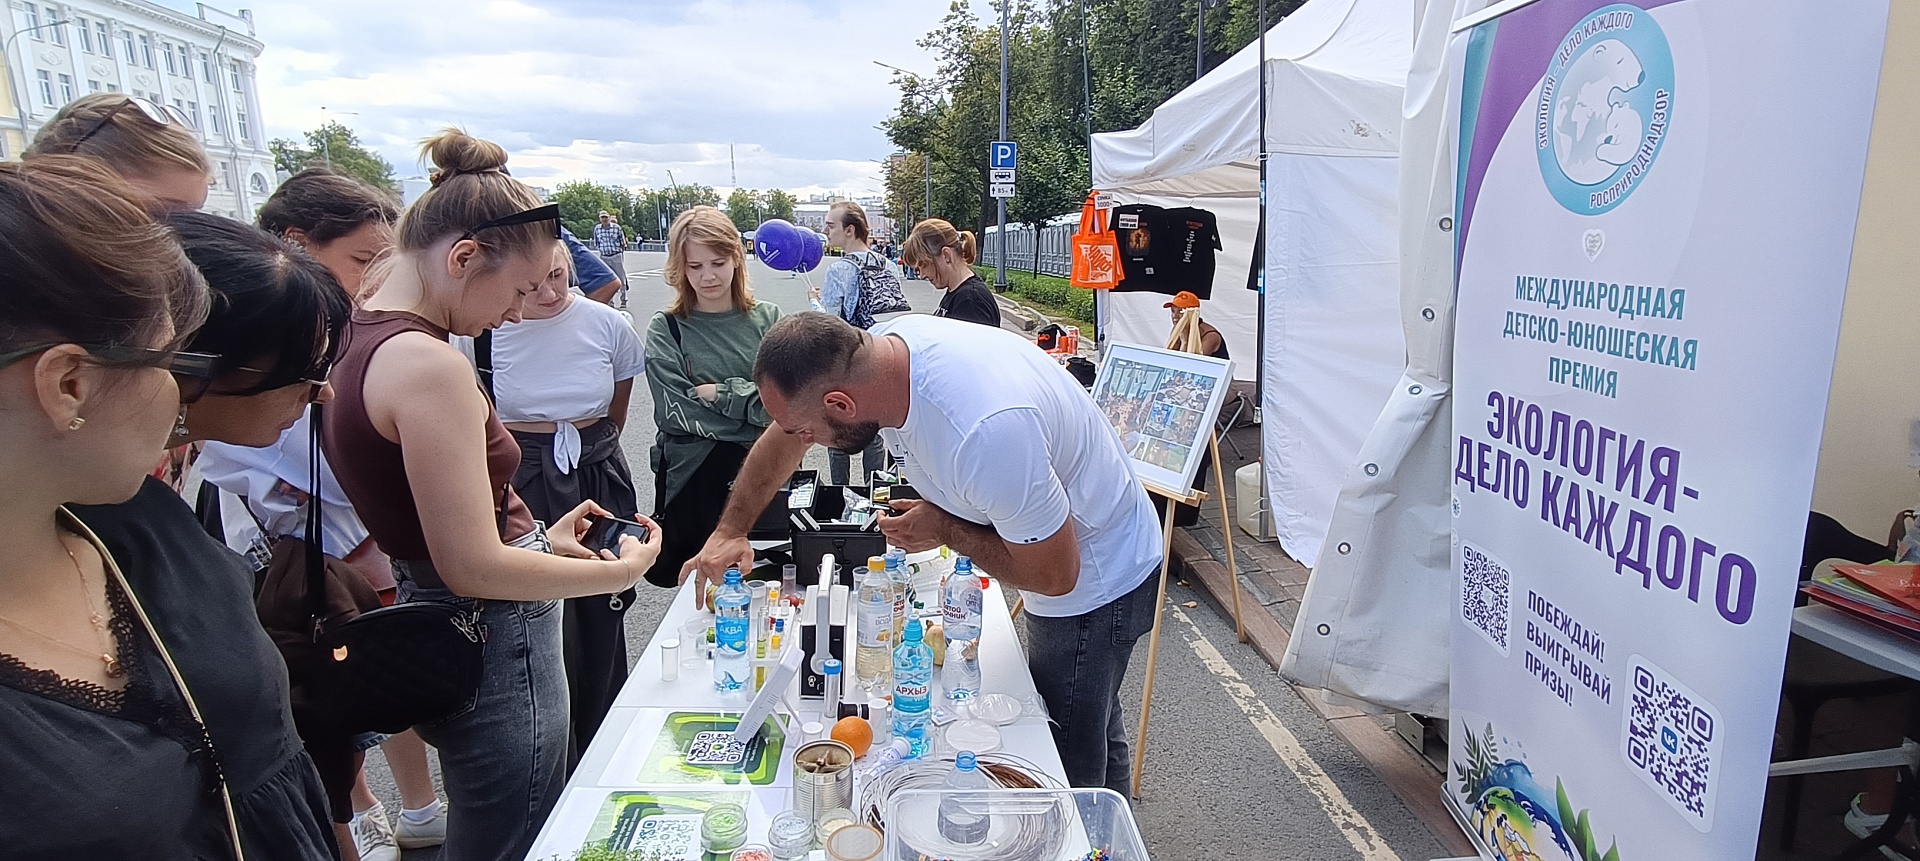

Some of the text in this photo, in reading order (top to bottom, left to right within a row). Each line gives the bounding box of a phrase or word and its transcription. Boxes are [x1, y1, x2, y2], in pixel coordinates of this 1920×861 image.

[1539, 77, 1556, 148] ЭКОЛОГИЯ
[1558, 31, 1582, 67] ДЕЛО
[1583, 12, 1634, 38] КАЖДОГО
[998, 145, 1011, 165] P
[1589, 89, 1669, 208] РОСПРИРОДНАДЗОР
[1515, 275, 1685, 320] МЕЖДУНАРОДНАЯ
[1503, 311, 1698, 371] ДЕТСКО-ЮНОШЕСКАЯ
[1549, 357, 1618, 399] ПРЕМИЯ
[1487, 391, 1700, 513] ЭКОЛОГИЯ-
[1455, 436, 1757, 625] ДЕЛО КАЖДОГО
[1527, 590, 1605, 664] ПОБЕЖДАЙ!
[895, 685, 927, 696] АРХЫЗ
[1524, 650, 1574, 707] ПРИЗЫ!
[1526, 621, 1611, 705] ВЫИГРЫВАЙ
